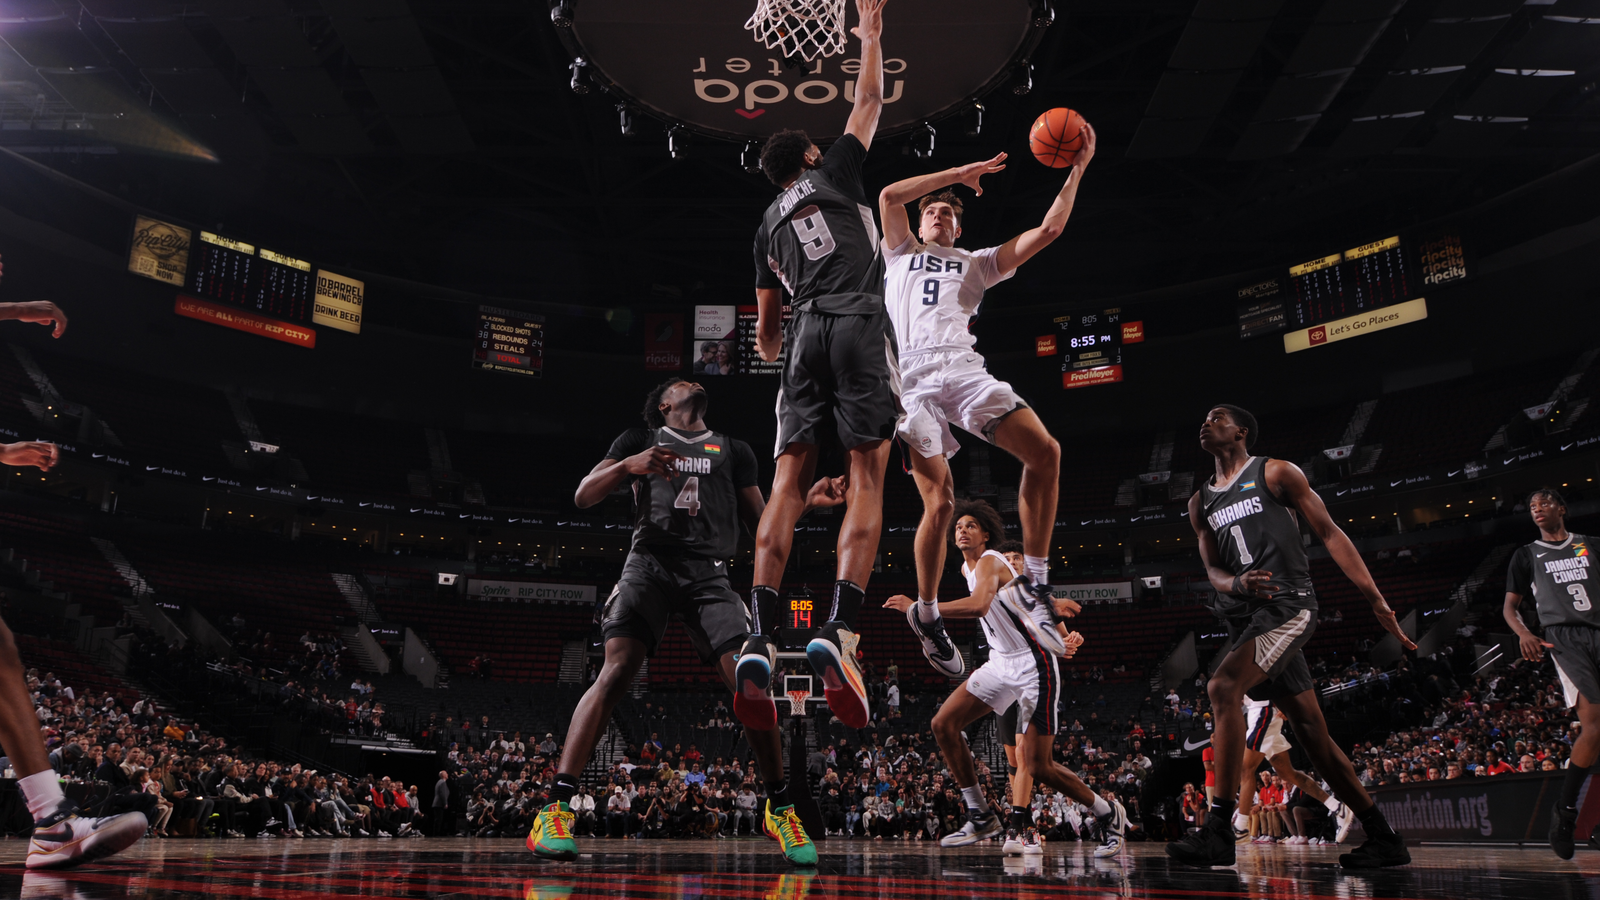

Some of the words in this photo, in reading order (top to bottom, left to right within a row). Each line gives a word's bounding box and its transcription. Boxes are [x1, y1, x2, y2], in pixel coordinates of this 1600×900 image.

[693, 57, 907, 76] center
[693, 78, 905, 110] moda
[790, 204, 837, 261] 9
[134, 228, 160, 248] Rip
[160, 234, 189, 254] City
[1357, 240, 1386, 252] GUEST
[1419, 234, 1461, 253] ripcity
[1421, 245, 1464, 264] ripcity
[157, 261, 178, 272] SHOP
[909, 254, 963, 274] USA
[1303, 258, 1326, 268] HOME
[1422, 255, 1465, 274] ripcity
[156, 269, 174, 280] NOW
[1424, 266, 1467, 285] ripcity
[317, 286, 352, 303] BREWING
[318, 276, 327, 288] 10
[327, 278, 363, 298] BARREL
[922, 278, 940, 306] 9
[180, 301, 196, 312] WE
[197, 306, 215, 317] ARE
[215, 311, 233, 322] ALL
[234, 316, 255, 326] PART
[255, 321, 264, 329] OF
[265, 324, 284, 334] RIP
[285, 328, 310, 341] CITY
[315, 304, 339, 318] DRINK
[339, 310, 360, 324] BEER
[480, 314, 506, 324] BLAZERS
[483, 306, 541, 321] HUSTLEBOARD
[1108, 314, 1119, 323] 64
[484, 321, 490, 330] 2
[490, 323, 515, 333] BLOCKED
[514, 327, 532, 336] SHOTS
[698, 324, 722, 332] moda
[1059, 322, 1069, 330] 72
[1123, 326, 1138, 334] Fred
[1241, 314, 1284, 331] #DIRECTFAN
[1330, 324, 1351, 336] Let's
[1352, 320, 1367, 330] Go
[1368, 312, 1399, 326] Places
[477, 330, 489, 339] 38
[492, 333, 529, 345] REBOUNDS
[531, 339, 543, 348] 24
[1070, 334, 1096, 349] 8:55
[1100, 334, 1111, 343] PM
[1123, 331, 1142, 340] Meyer
[482, 340, 488, 349] 8
[494, 343, 525, 354] STEALS
[1037, 345, 1056, 353] Meyer
[496, 354, 522, 365] TOTAL
[645, 353, 681, 366] ripcity
[1061, 363, 1067, 372] 2
[1116, 355, 1122, 364] 3
[1070, 372, 1089, 382] Fred
[1088, 370, 1115, 379] Meyer
[666, 457, 711, 474] HANA
[674, 476, 701, 517] 4
[1207, 496, 1264, 531] BAHAMAS
[1230, 524, 1254, 565] 1
[1544, 556, 1590, 574] JAMAICA
[1552, 568, 1588, 584] CONGO
[481, 585, 511, 596] Sprite
[518, 587, 534, 597] RIP
[536, 588, 559, 598] CITY
[560, 589, 584, 599] ROW
[1053, 590, 1068, 599] RIP
[1070, 589, 1092, 599] CITY
[1095, 588, 1118, 598] ROW
[1566, 583, 1592, 612] 3
[790, 600, 814, 611] 8:05
[794, 610, 811, 628] 14
